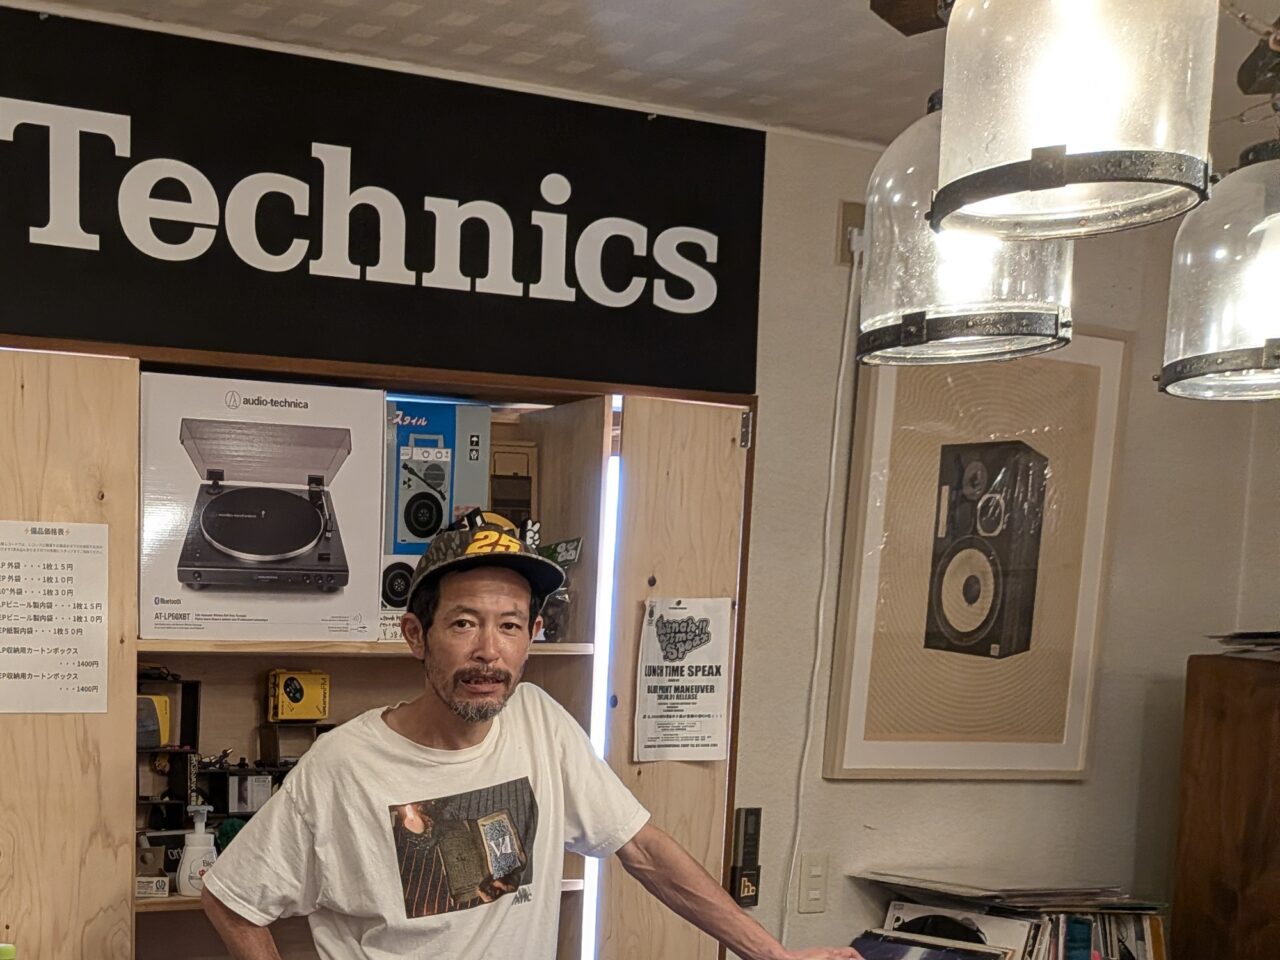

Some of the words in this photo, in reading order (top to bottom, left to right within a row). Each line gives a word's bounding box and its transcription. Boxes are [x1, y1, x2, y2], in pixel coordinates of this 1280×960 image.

[242, 395, 309, 410] audio-technica
[465, 530, 522, 554] 25
[665, 665, 685, 677] TIME
[687, 665, 722, 677] SPEAX
[674, 685, 715, 694] MANEUVER
